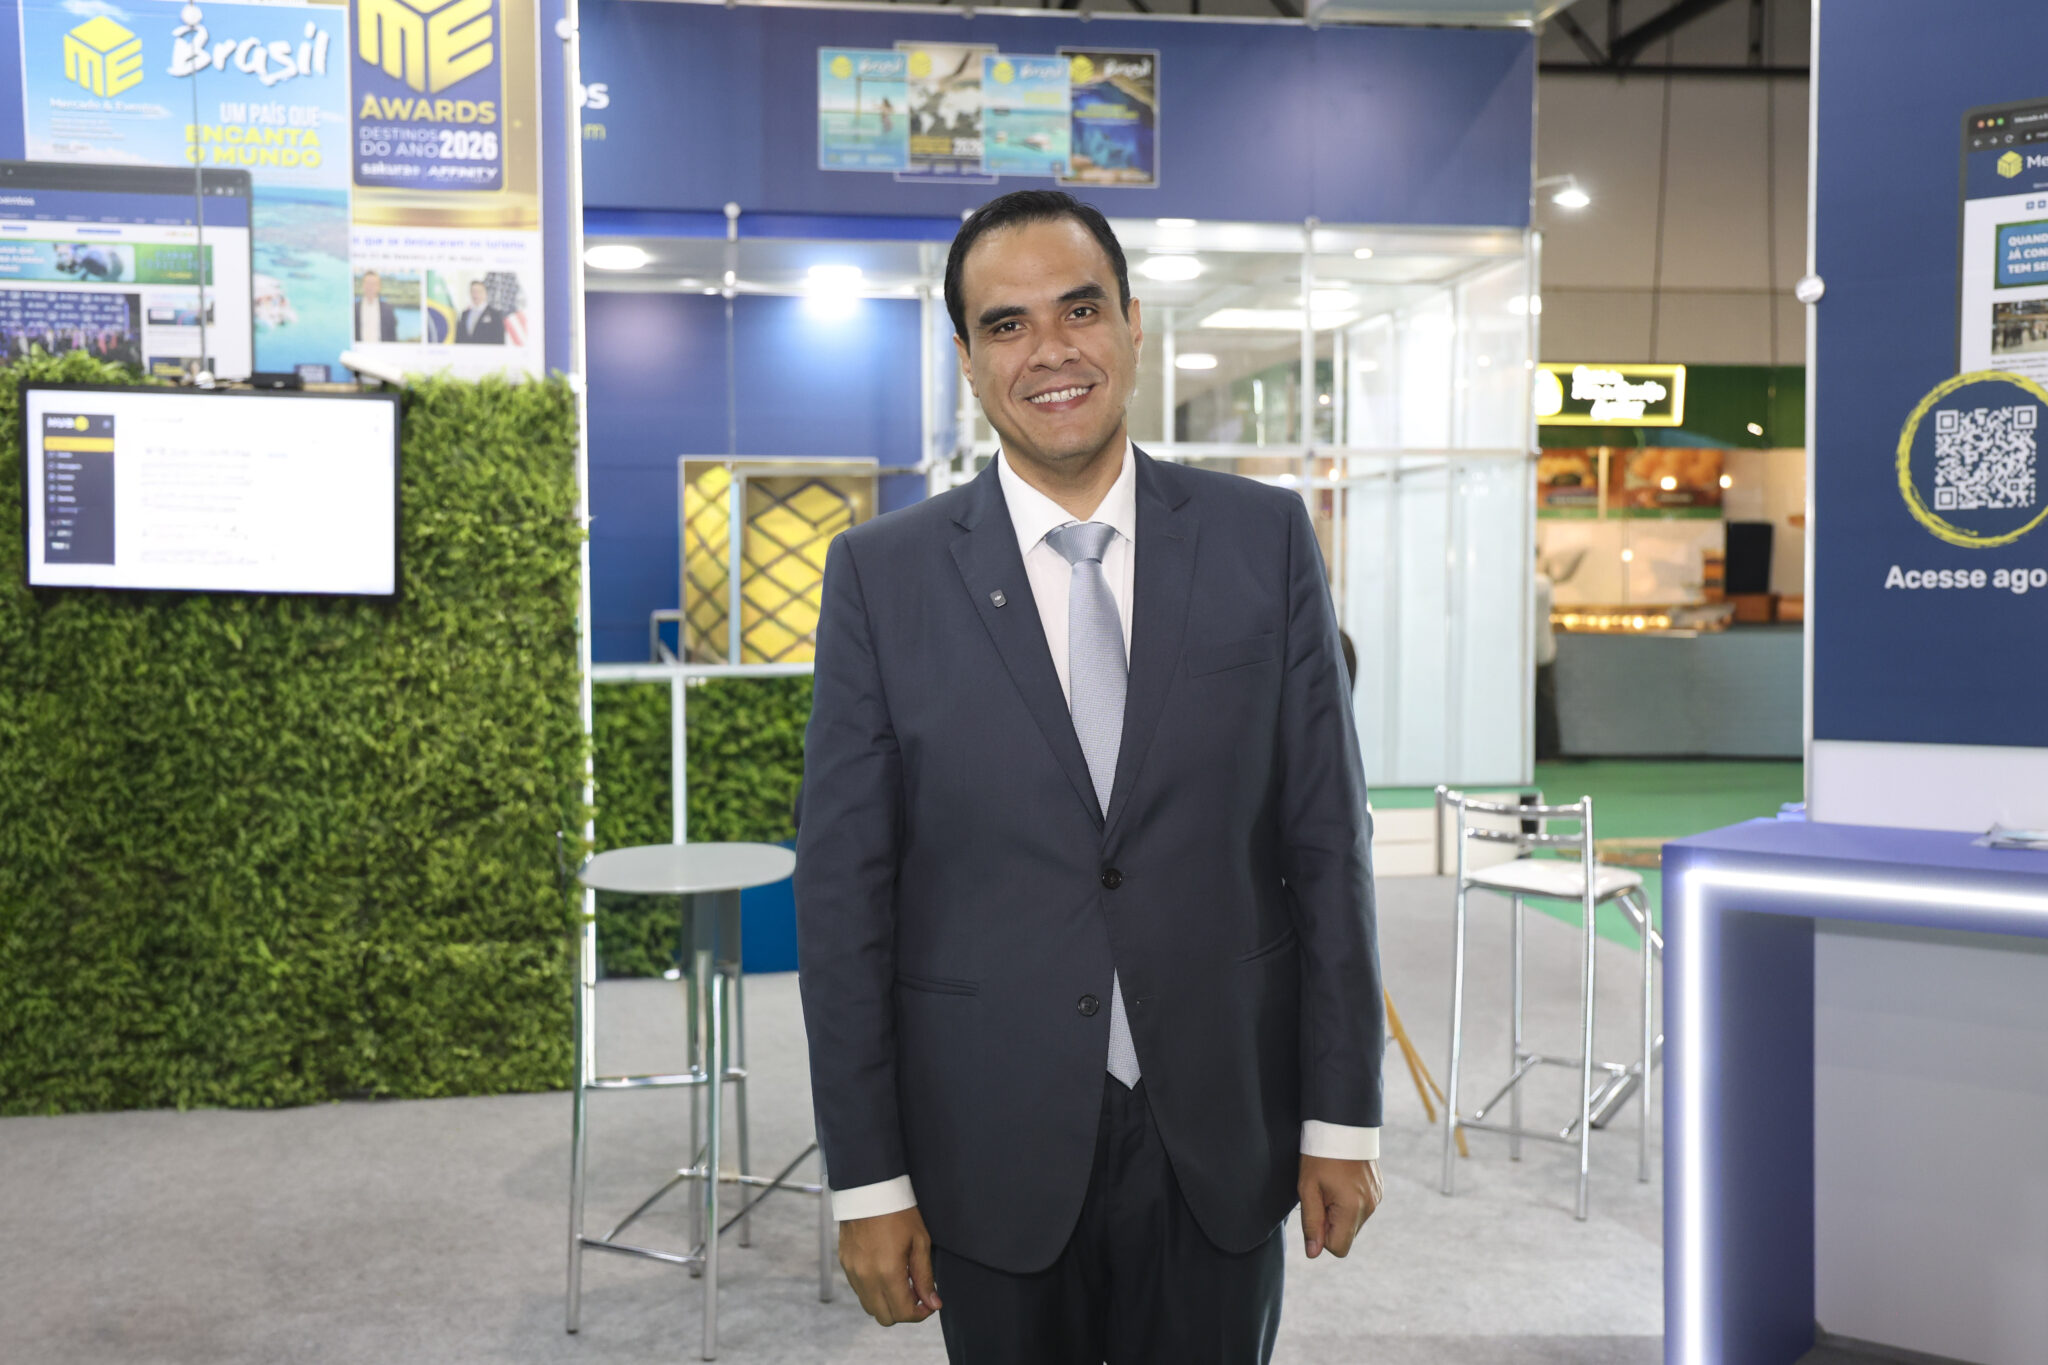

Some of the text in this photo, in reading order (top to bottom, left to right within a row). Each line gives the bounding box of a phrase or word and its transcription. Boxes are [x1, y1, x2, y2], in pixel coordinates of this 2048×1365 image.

[166, 21, 330, 87] Brasil
[220, 101, 320, 128] UM PAÍS QUE
[359, 94, 496, 124] AWARDS
[185, 124, 320, 148] ENCANTA
[360, 126, 438, 143] DESTINOS
[438, 130, 499, 161] 2026
[185, 146, 322, 168] O MUNDO
[360, 141, 439, 159] DO ANO
[427, 165, 499, 180] AFFINITY
[2007, 262, 2032, 275] TEM
[1884, 564, 2048, 595] Acesse ago
